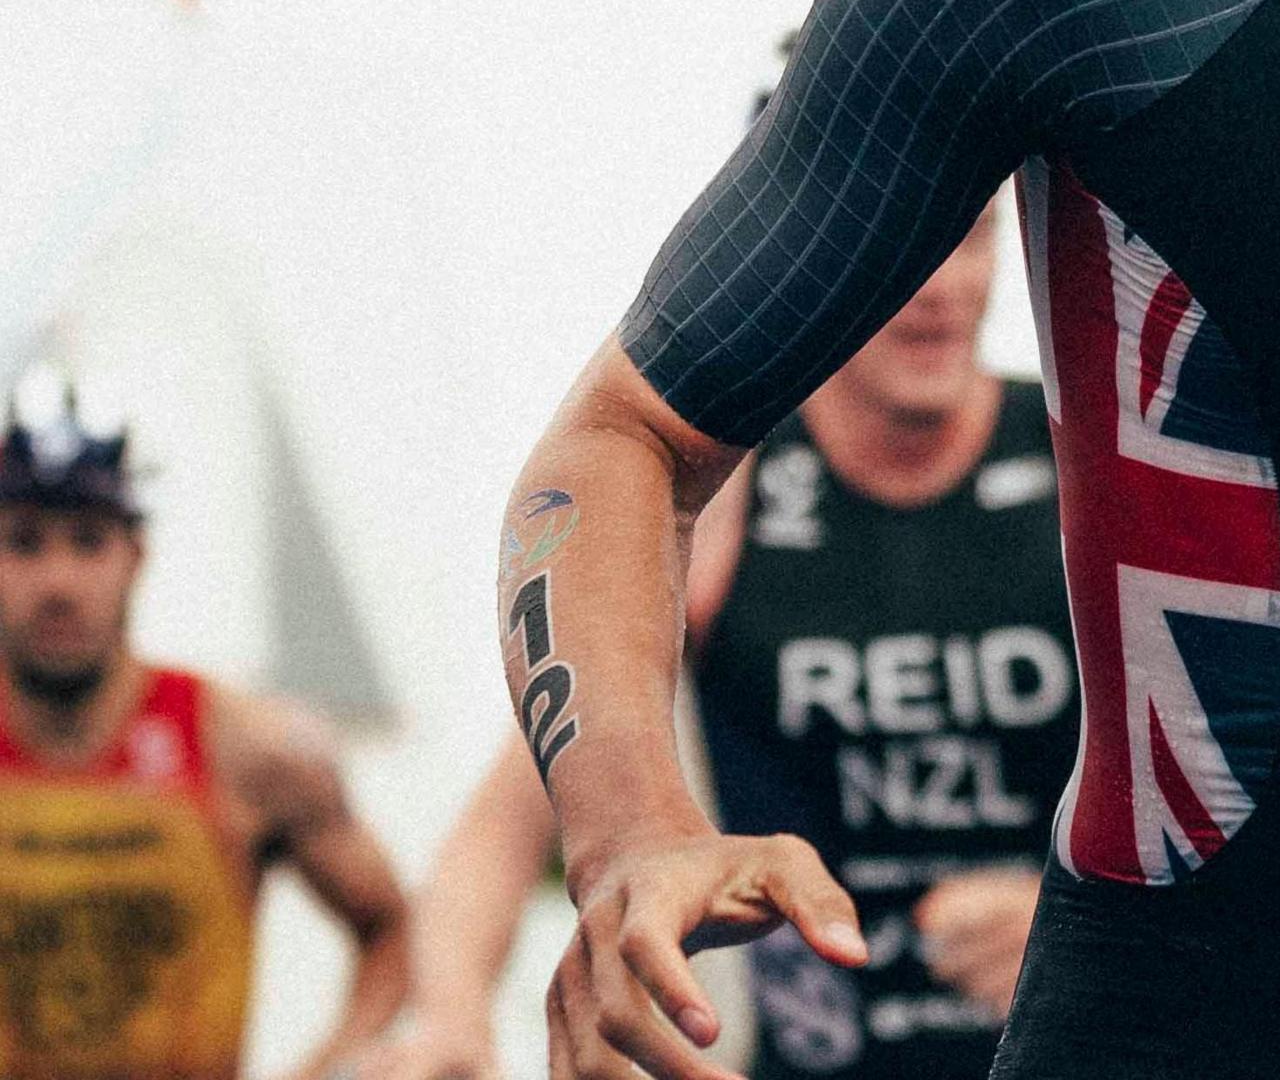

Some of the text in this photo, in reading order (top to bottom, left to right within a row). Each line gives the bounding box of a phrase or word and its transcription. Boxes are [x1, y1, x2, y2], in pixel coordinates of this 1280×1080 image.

[507, 568, 581, 788] 12
[776, 626, 1074, 738] REID
[836, 738, 1032, 830] NZL
